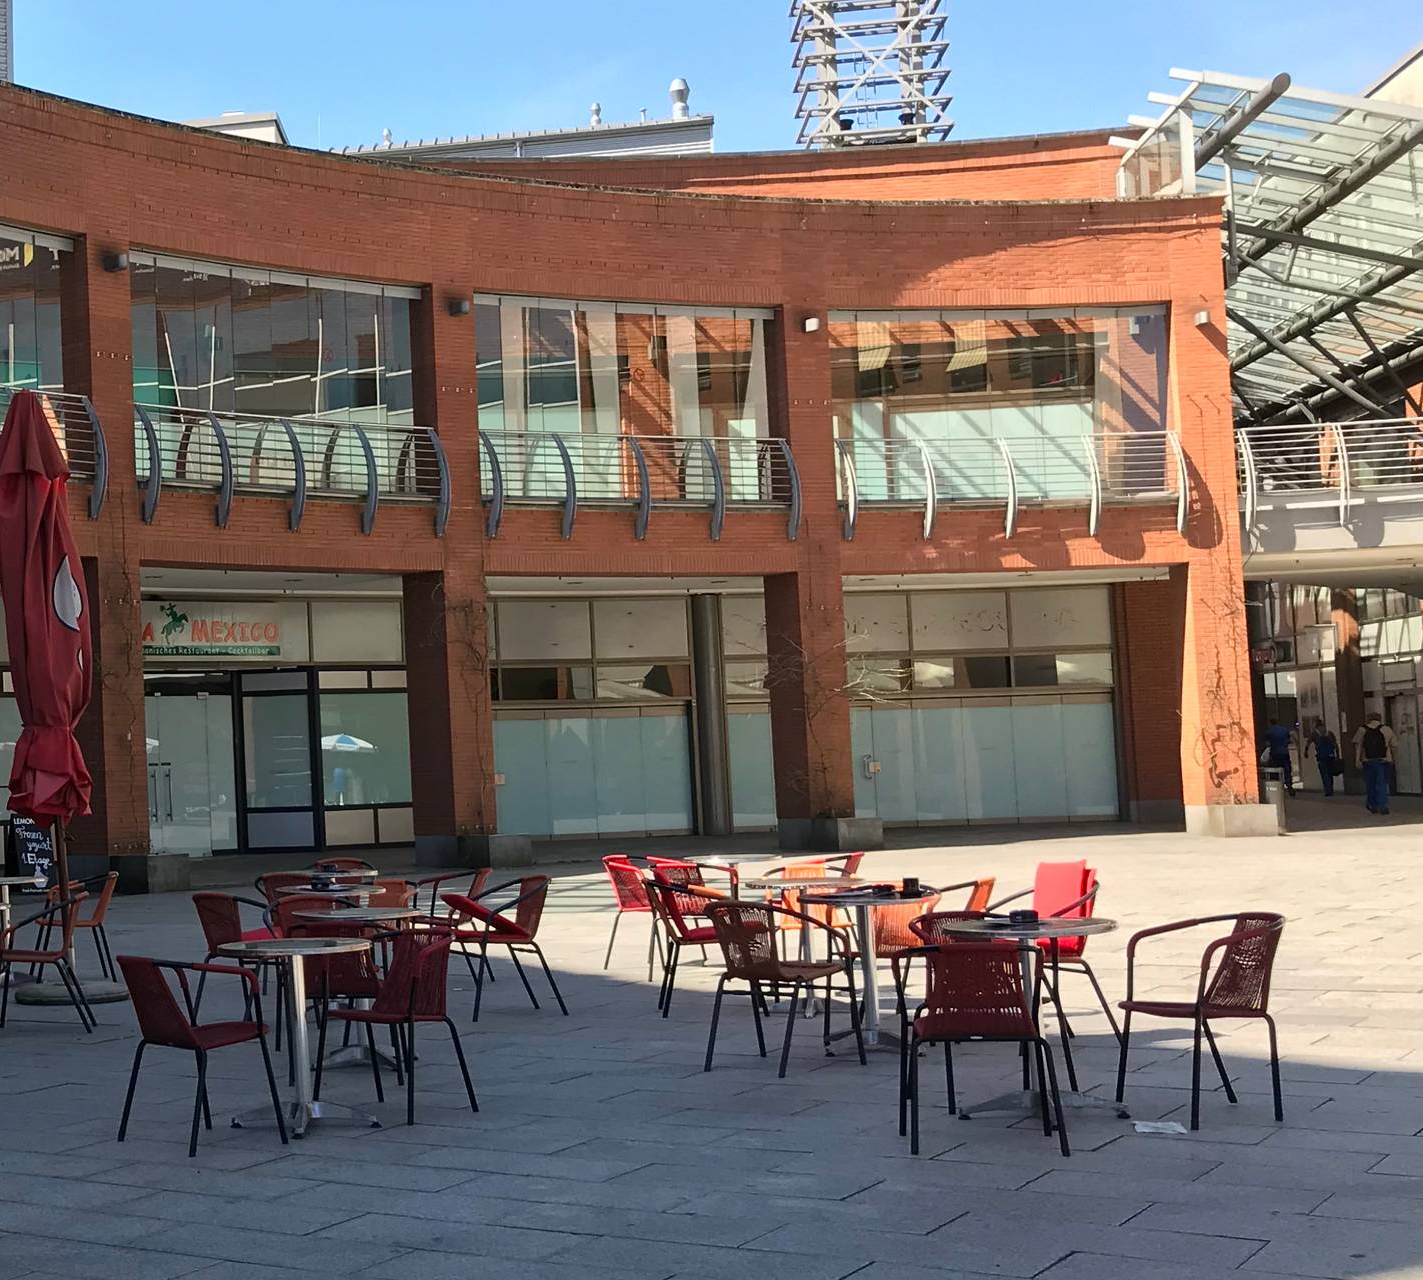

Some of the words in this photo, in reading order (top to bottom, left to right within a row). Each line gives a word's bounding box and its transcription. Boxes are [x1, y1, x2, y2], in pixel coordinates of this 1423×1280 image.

[191, 619, 280, 643] MEXICO
[178, 646, 219, 655] Restaurant
[227, 646, 270, 655] Cocktailbar
